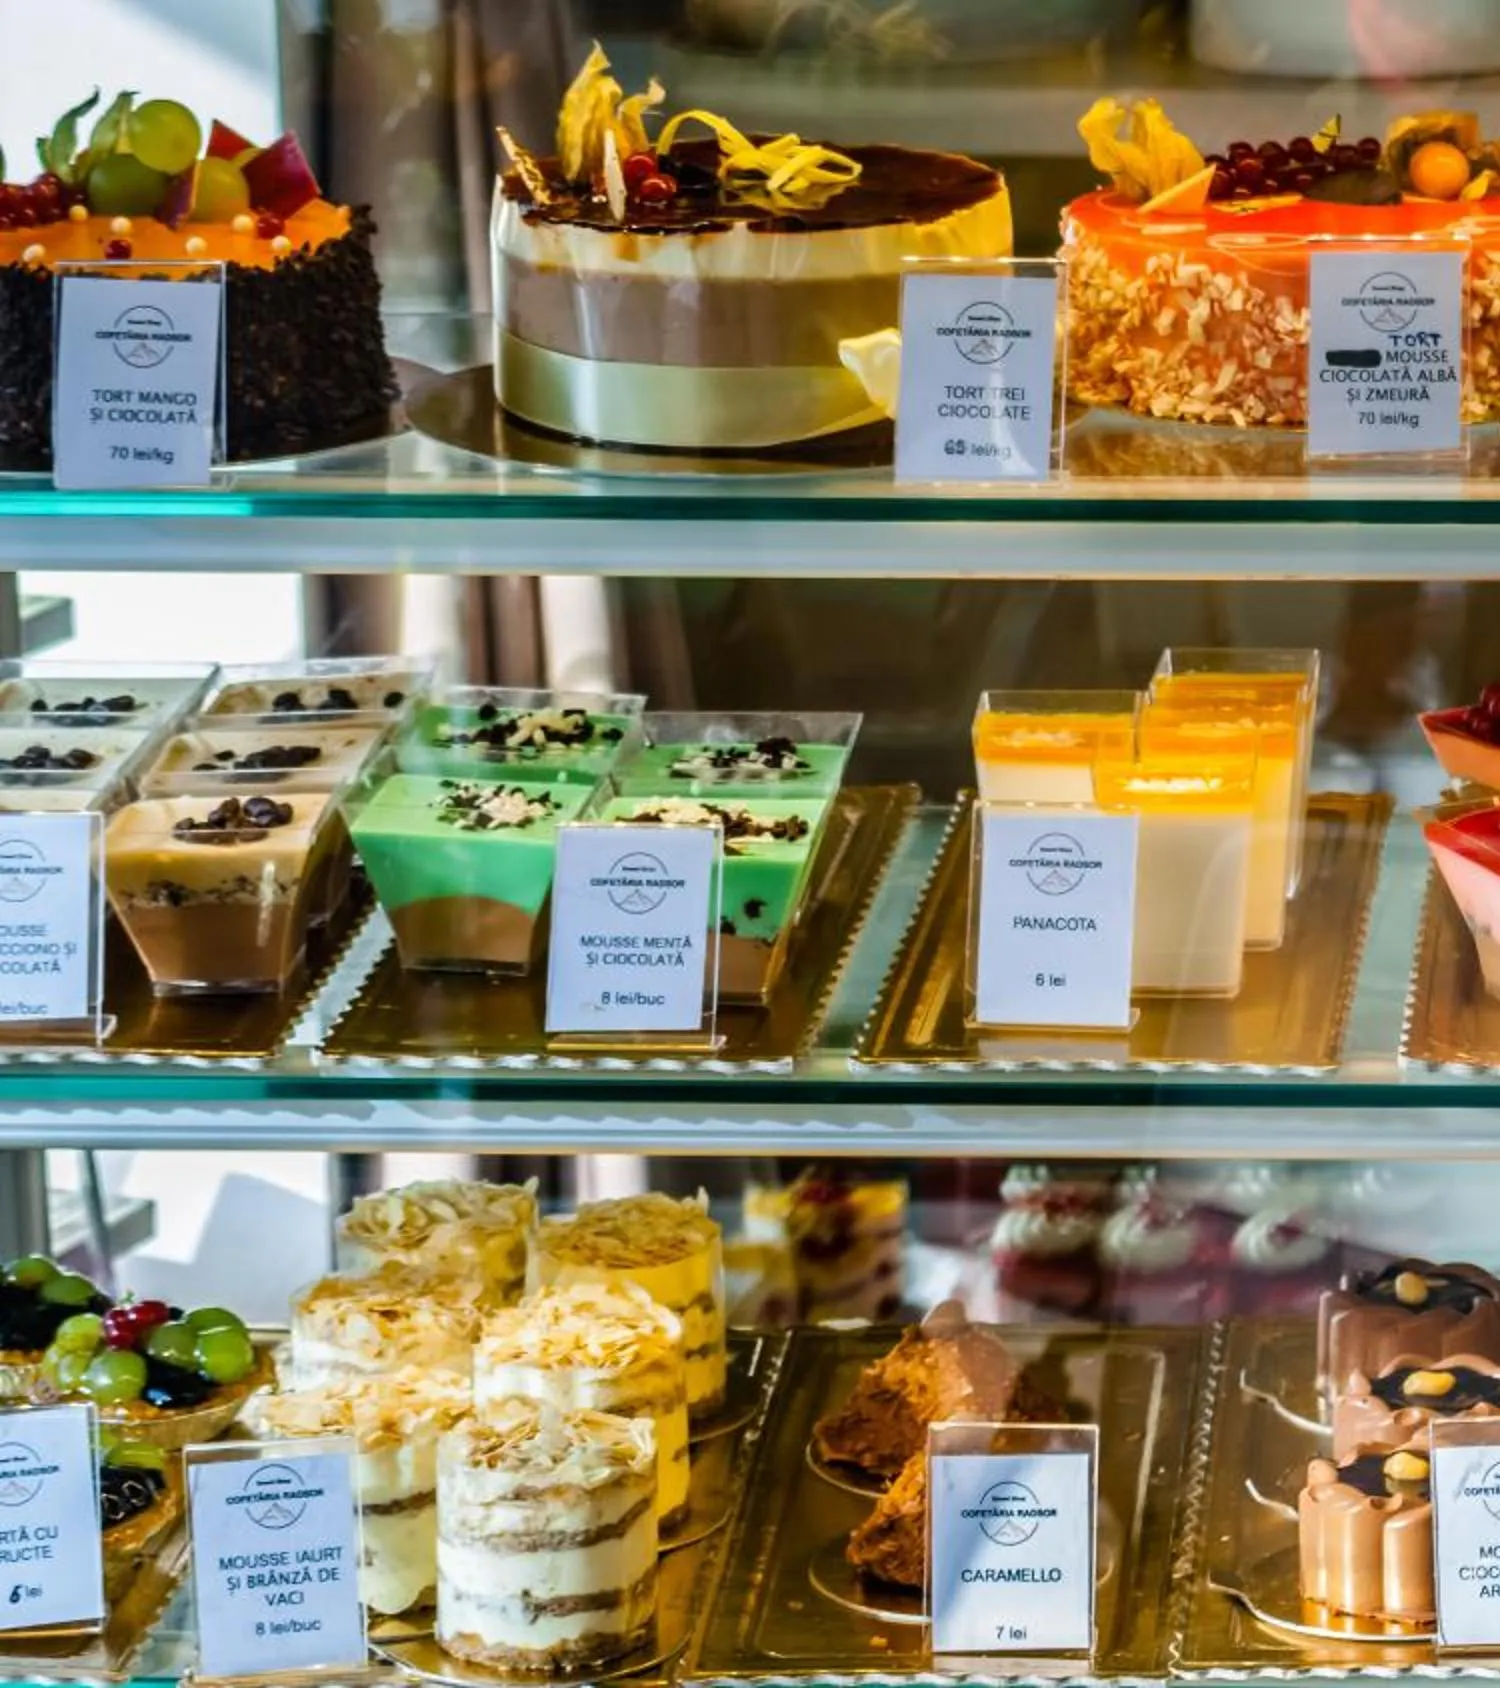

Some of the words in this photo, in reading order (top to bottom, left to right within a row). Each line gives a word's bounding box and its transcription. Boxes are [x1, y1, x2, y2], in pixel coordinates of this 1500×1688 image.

[1388, 332, 1441, 347] TORT
[1385, 350, 1449, 363] MOUSSE
[1319, 366, 1413, 383] CIOCOLATĂ
[1418, 366, 1457, 382] ALBĂ
[91, 388, 133, 403] TORT
[138, 391, 197, 406] MANGO
[944, 385, 985, 399] TORT
[1365, 385, 1431, 401] ZMEURĂ
[1359, 412, 1375, 425] 70
[1380, 412, 1420, 428] lei/kg
[110, 445, 129, 460] 70
[133, 447, 174, 464] lei/kg
[0, 925, 47, 937] OUSSE
[1013, 916, 1097, 932] PANACOTA
[580, 935, 640, 949] MOUSSE
[643, 935, 693, 949] MENTĂ
[602, 951, 685, 966] CIOCOLATĂ
[0, 960, 61, 974] COLATĂ
[1035, 973, 1045, 986] 6
[1049, 973, 1066, 987] lei
[601, 991, 611, 1005] 8
[615, 991, 665, 1005] lei/buc
[0, 1526, 31, 1544] RTĂ
[34, 1526, 60, 1540] CU
[0, 1546, 54, 1564] RUCTE
[219, 1551, 291, 1570] MOUSSE
[295, 1546, 343, 1564] IAURT
[318, 1567, 341, 1583] DE
[961, 1568, 1062, 1583] CARAMELLO
[9, 1584, 23, 1604] 6
[25, 1584, 43, 1599] lei
[264, 1591, 305, 1606] VACI
[255, 1622, 266, 1636] 8
[270, 1619, 321, 1635] lei/buc
[996, 1626, 1005, 1639] 7
[1009, 1626, 1027, 1639] lei
